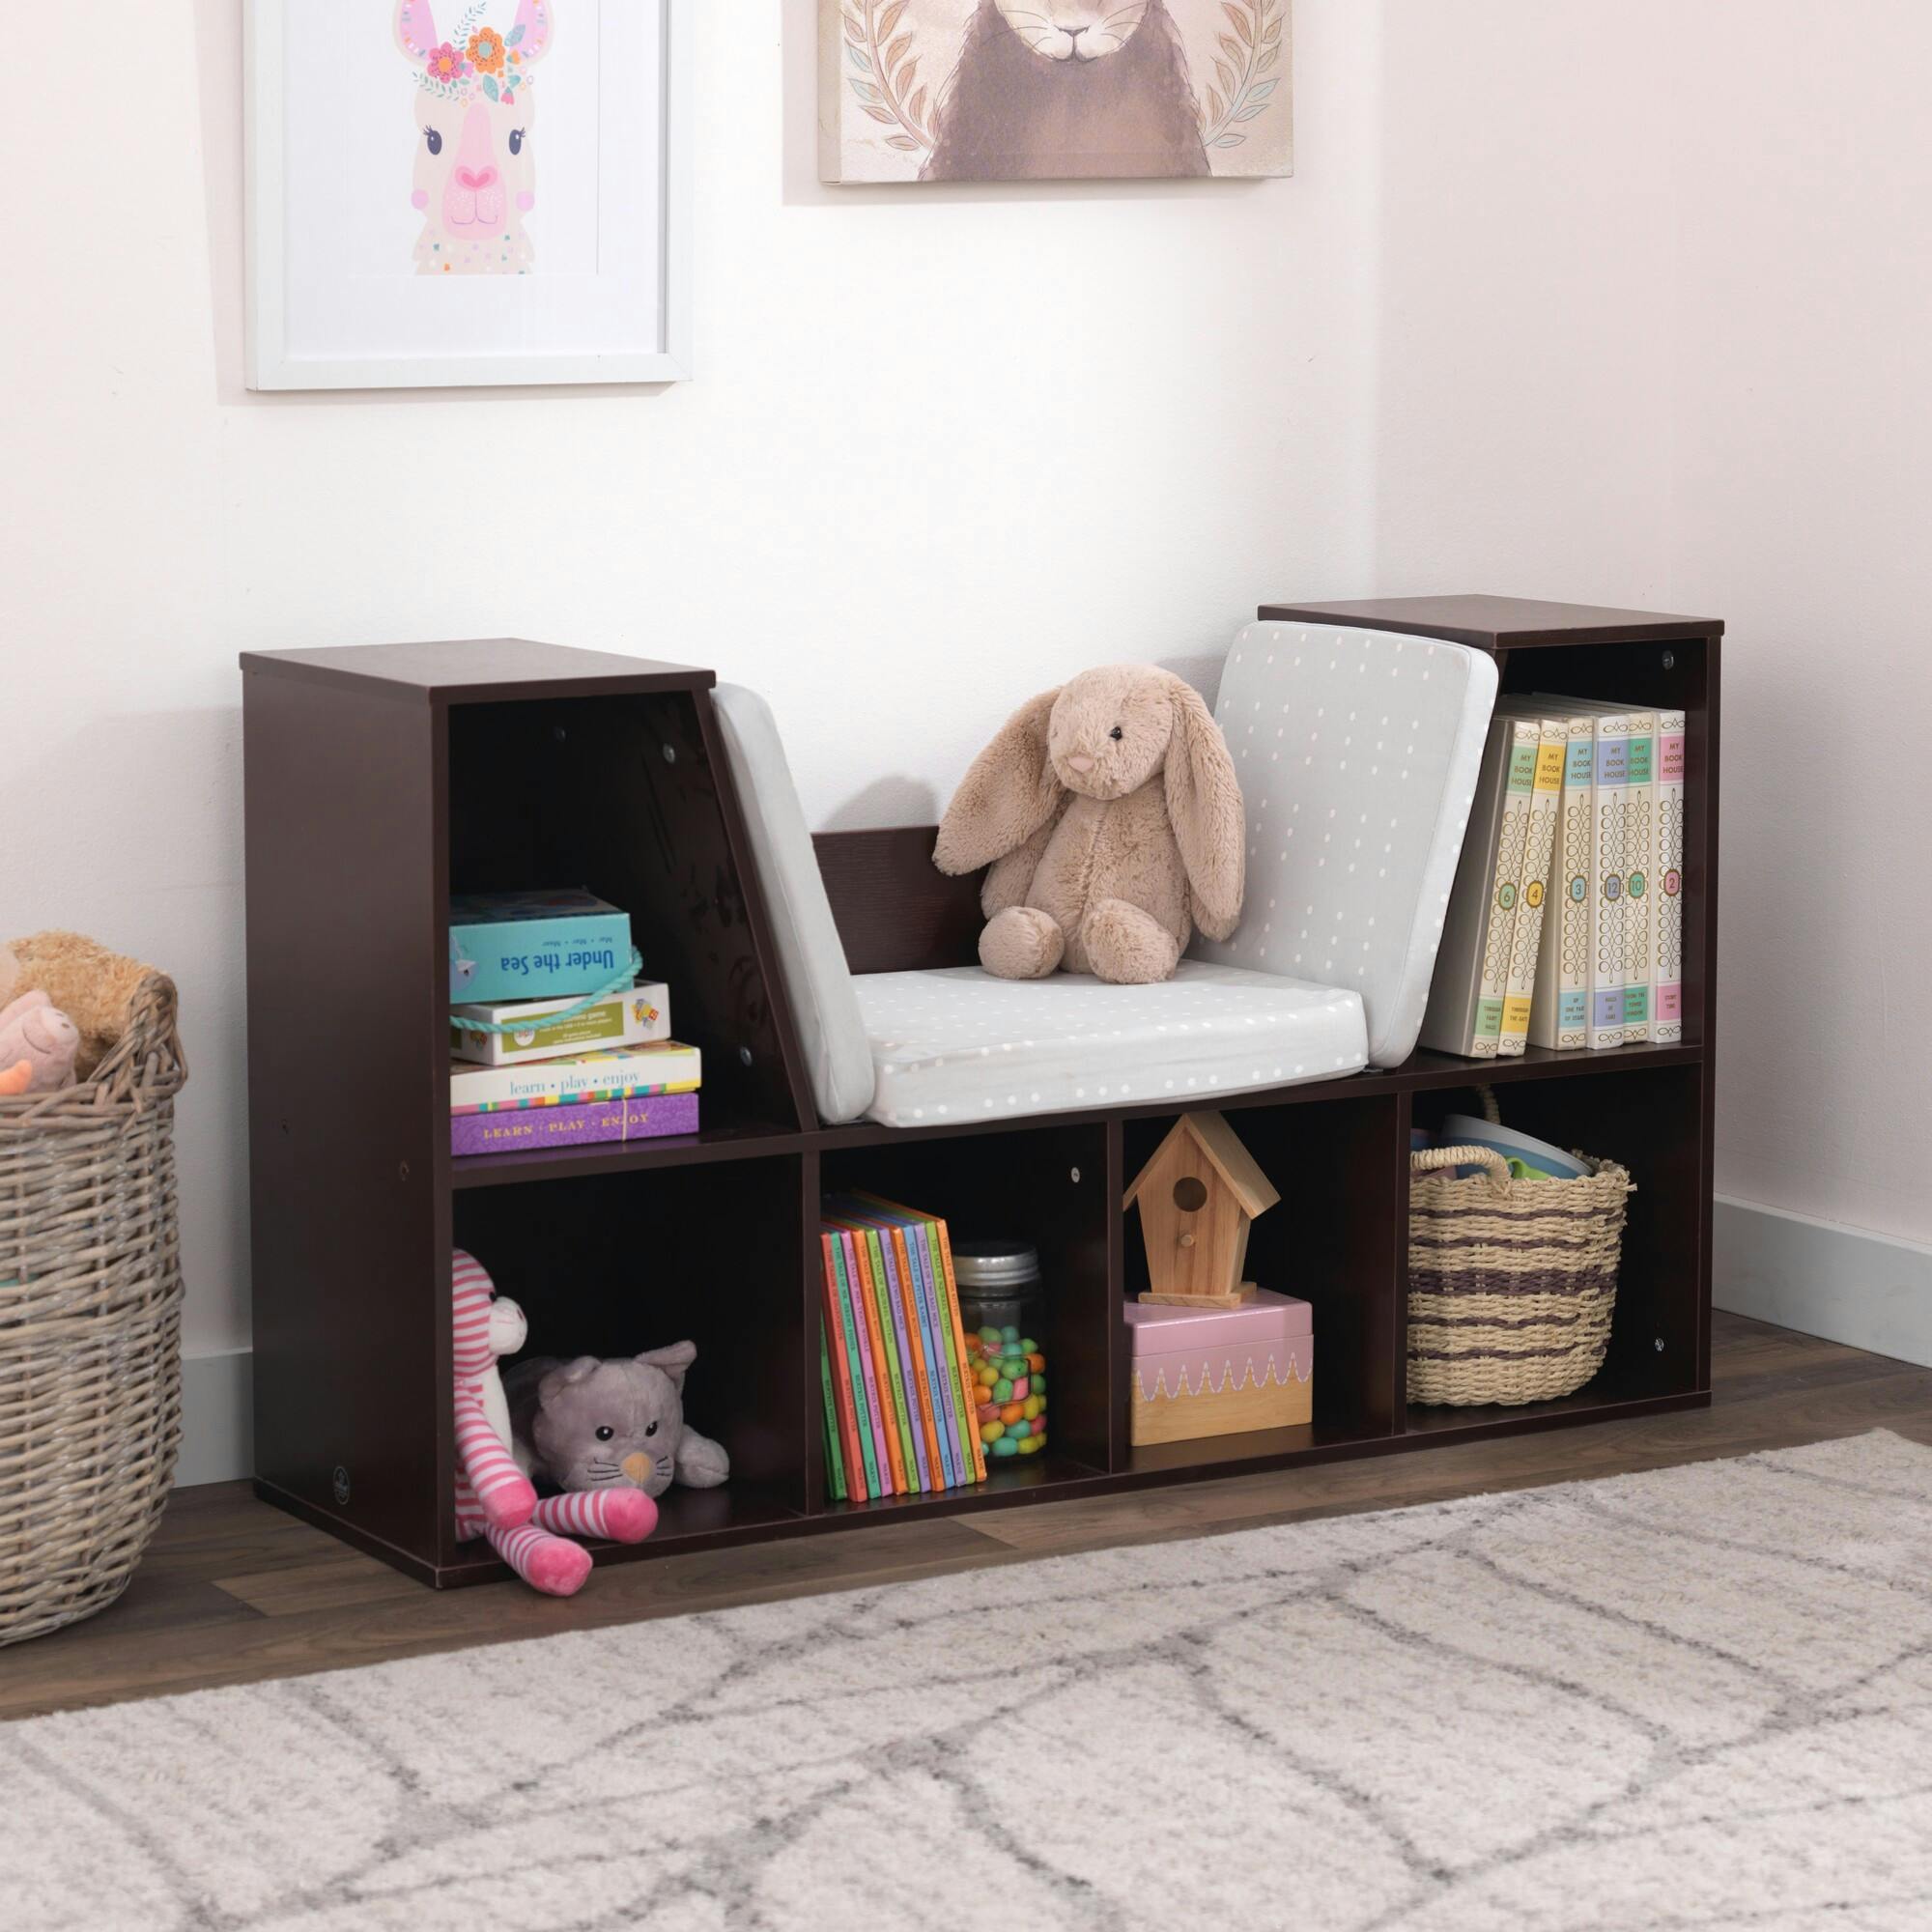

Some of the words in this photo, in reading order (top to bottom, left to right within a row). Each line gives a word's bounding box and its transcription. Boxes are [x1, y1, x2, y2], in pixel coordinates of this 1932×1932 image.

[1576, 884, 1581, 895] 3
[1607, 883, 1618, 894] 12
[1632, 880, 1642, 892] 10
[1669, 878, 1676, 889] 2
[1504, 891, 1511, 901] 6
[1531, 890, 1538, 899] 4
[501, 955, 529, 975] Sea
[533, 953, 559, 973] the
[565, 950, 613, 970] Under
[510, 1081, 546, 1095] learn
[560, 1075, 588, 1094] play
[603, 1069, 639, 1086] enjoy
[484, 1125, 532, 1139] LEARN
[549, 1120, 585, 1132] PLAY
[602, 1113, 648, 1127] ENOY
[894, 1373, 902, 1400] BEATRIX
[906, 1369, 915, 1396] BEATRIX
[929, 1370, 938, 1396] BEATRIX
[940, 1366, 949, 1392] BEATRIX
